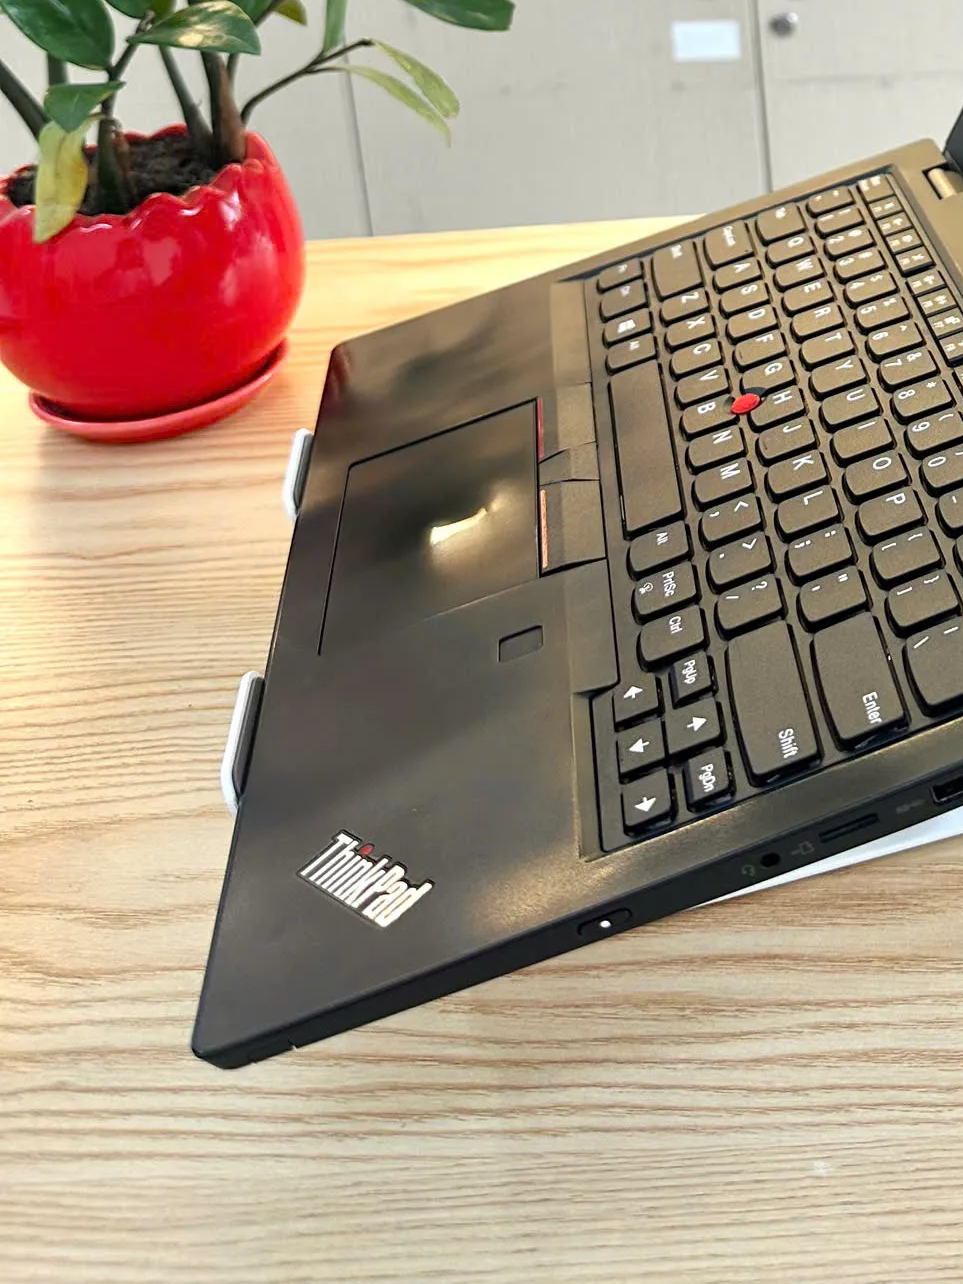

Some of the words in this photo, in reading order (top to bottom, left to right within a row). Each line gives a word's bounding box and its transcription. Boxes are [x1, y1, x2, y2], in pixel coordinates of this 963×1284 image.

[787, 236, 804, 248] Q
[828, 235, 845, 244] 2
[796, 258, 814, 271] W
[839, 257, 855, 266] 3
[733, 263, 751, 273] A
[741, 284, 758, 295] S
[803, 281, 822, 293] E
[849, 281, 865, 289] 4
[681, 291, 699, 304] Z
[748, 308, 766, 320] D
[814, 306, 831, 318] R
[860, 305, 878, 314] 5
[686, 316, 705, 329] X
[756, 334, 774, 343] F
[824, 332, 842, 342] T
[872, 331, 889, 340] 6
[693, 343, 711, 355] C
[883, 358, 902, 367] 7
[906, 351, 922, 362] &
[764, 362, 783, 376] G
[835, 359, 854, 370] Y
[699, 369, 719, 381] V
[772, 390, 793, 405] H
[846, 388, 866, 401] U
[897, 389, 916, 400] 8
[697, 401, 716, 414] B
[782, 424, 802, 433] J
[912, 421, 930, 432] 9
[712, 429, 732, 445] N
[792, 455, 814, 470] K
[872, 456, 892, 470] O
[927, 456, 947, 467] 0
[720, 462, 740, 480] M
[803, 490, 824, 506] L
[886, 492, 906, 506] P
[656, 531, 670, 546] Alt
[662, 571, 675, 598] PrtSc
[751, 580, 768, 592] ?
[669, 615, 683, 635] Ctrl
[682, 658, 697, 685] PgUp
[862, 691, 882, 725] Enter
[778, 728, 798, 759] Shift
[699, 763, 715, 793] PgDn
[300, 832, 433, 928] ThinkPad
